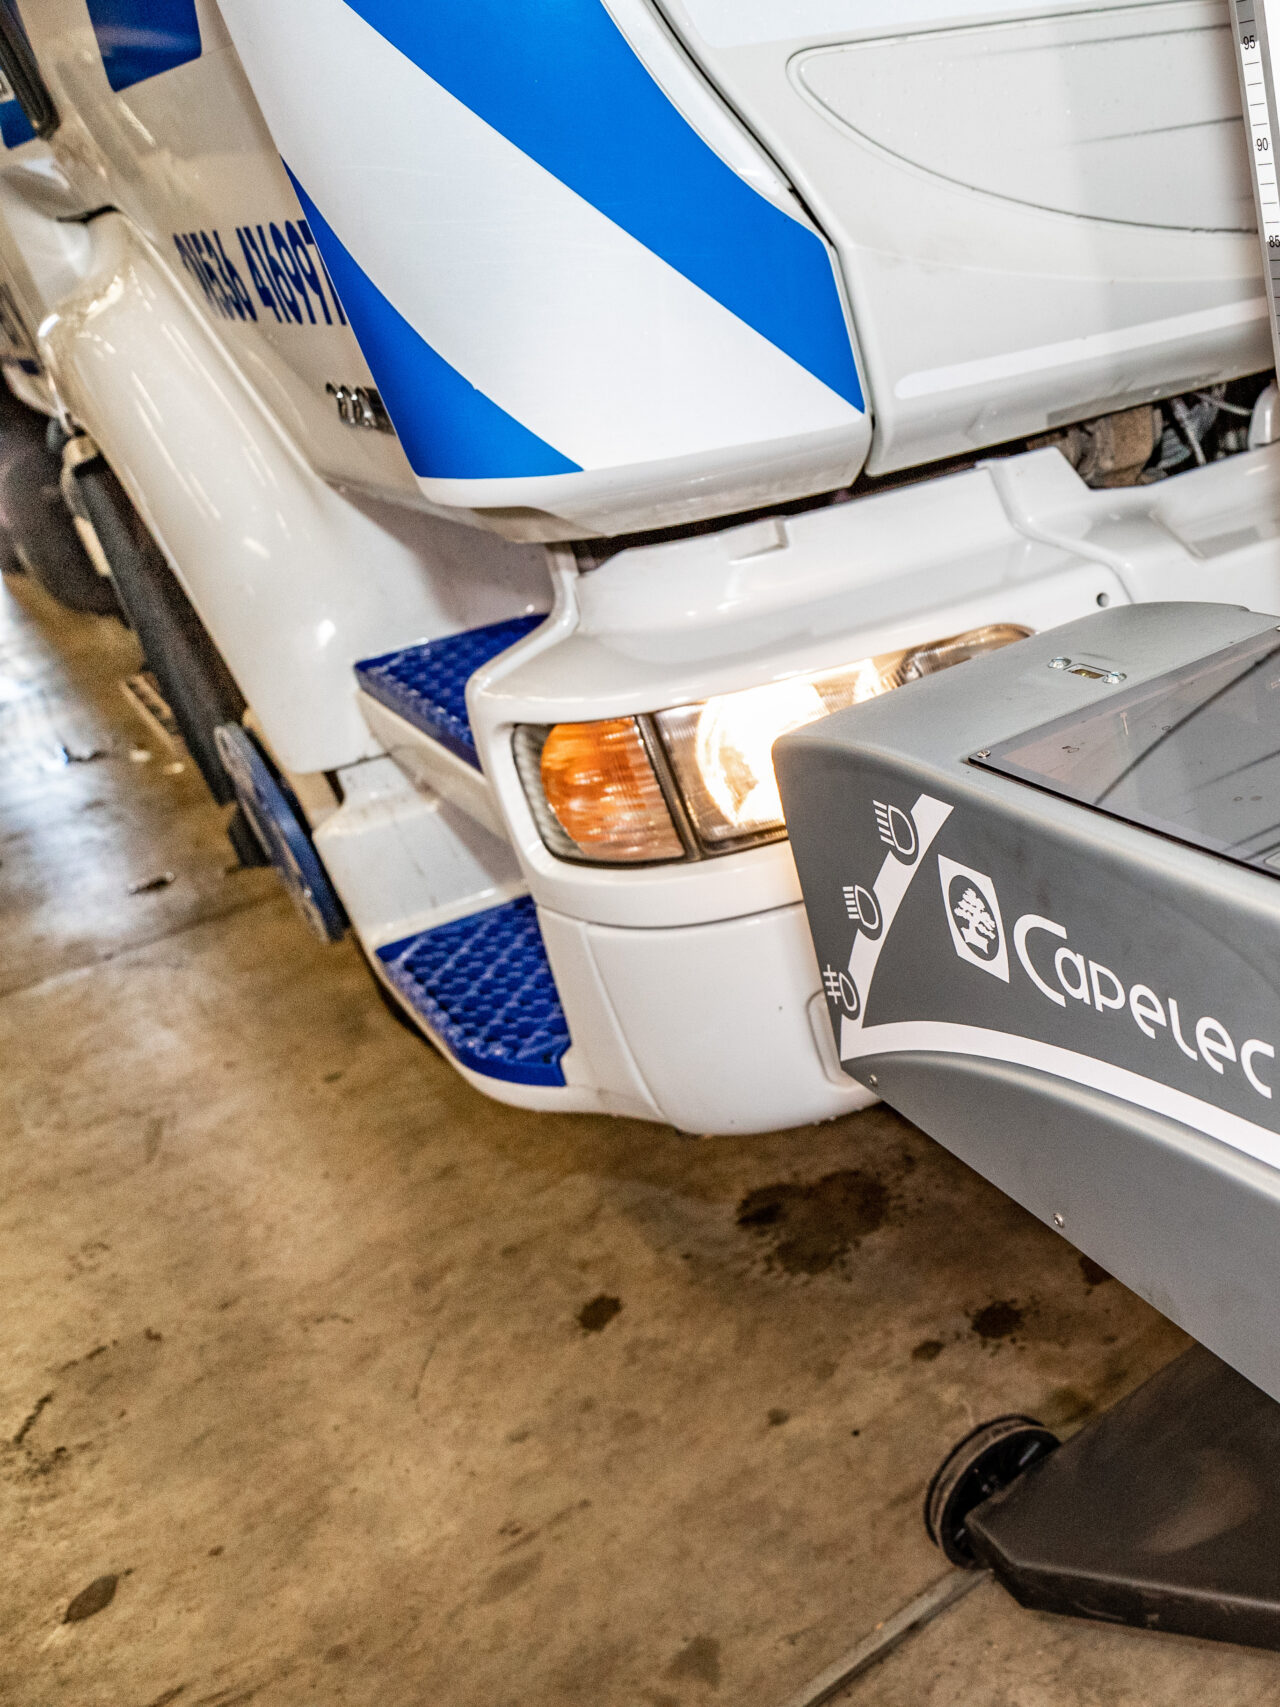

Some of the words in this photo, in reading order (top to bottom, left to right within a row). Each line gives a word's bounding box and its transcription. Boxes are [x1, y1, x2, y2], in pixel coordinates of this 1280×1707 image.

[1241, 35, 1256, 51] 95
[1256, 137, 1269, 152] 90
[1268, 234, 1280, 249] 85
[1013, 913, 1275, 1100] Capelec
